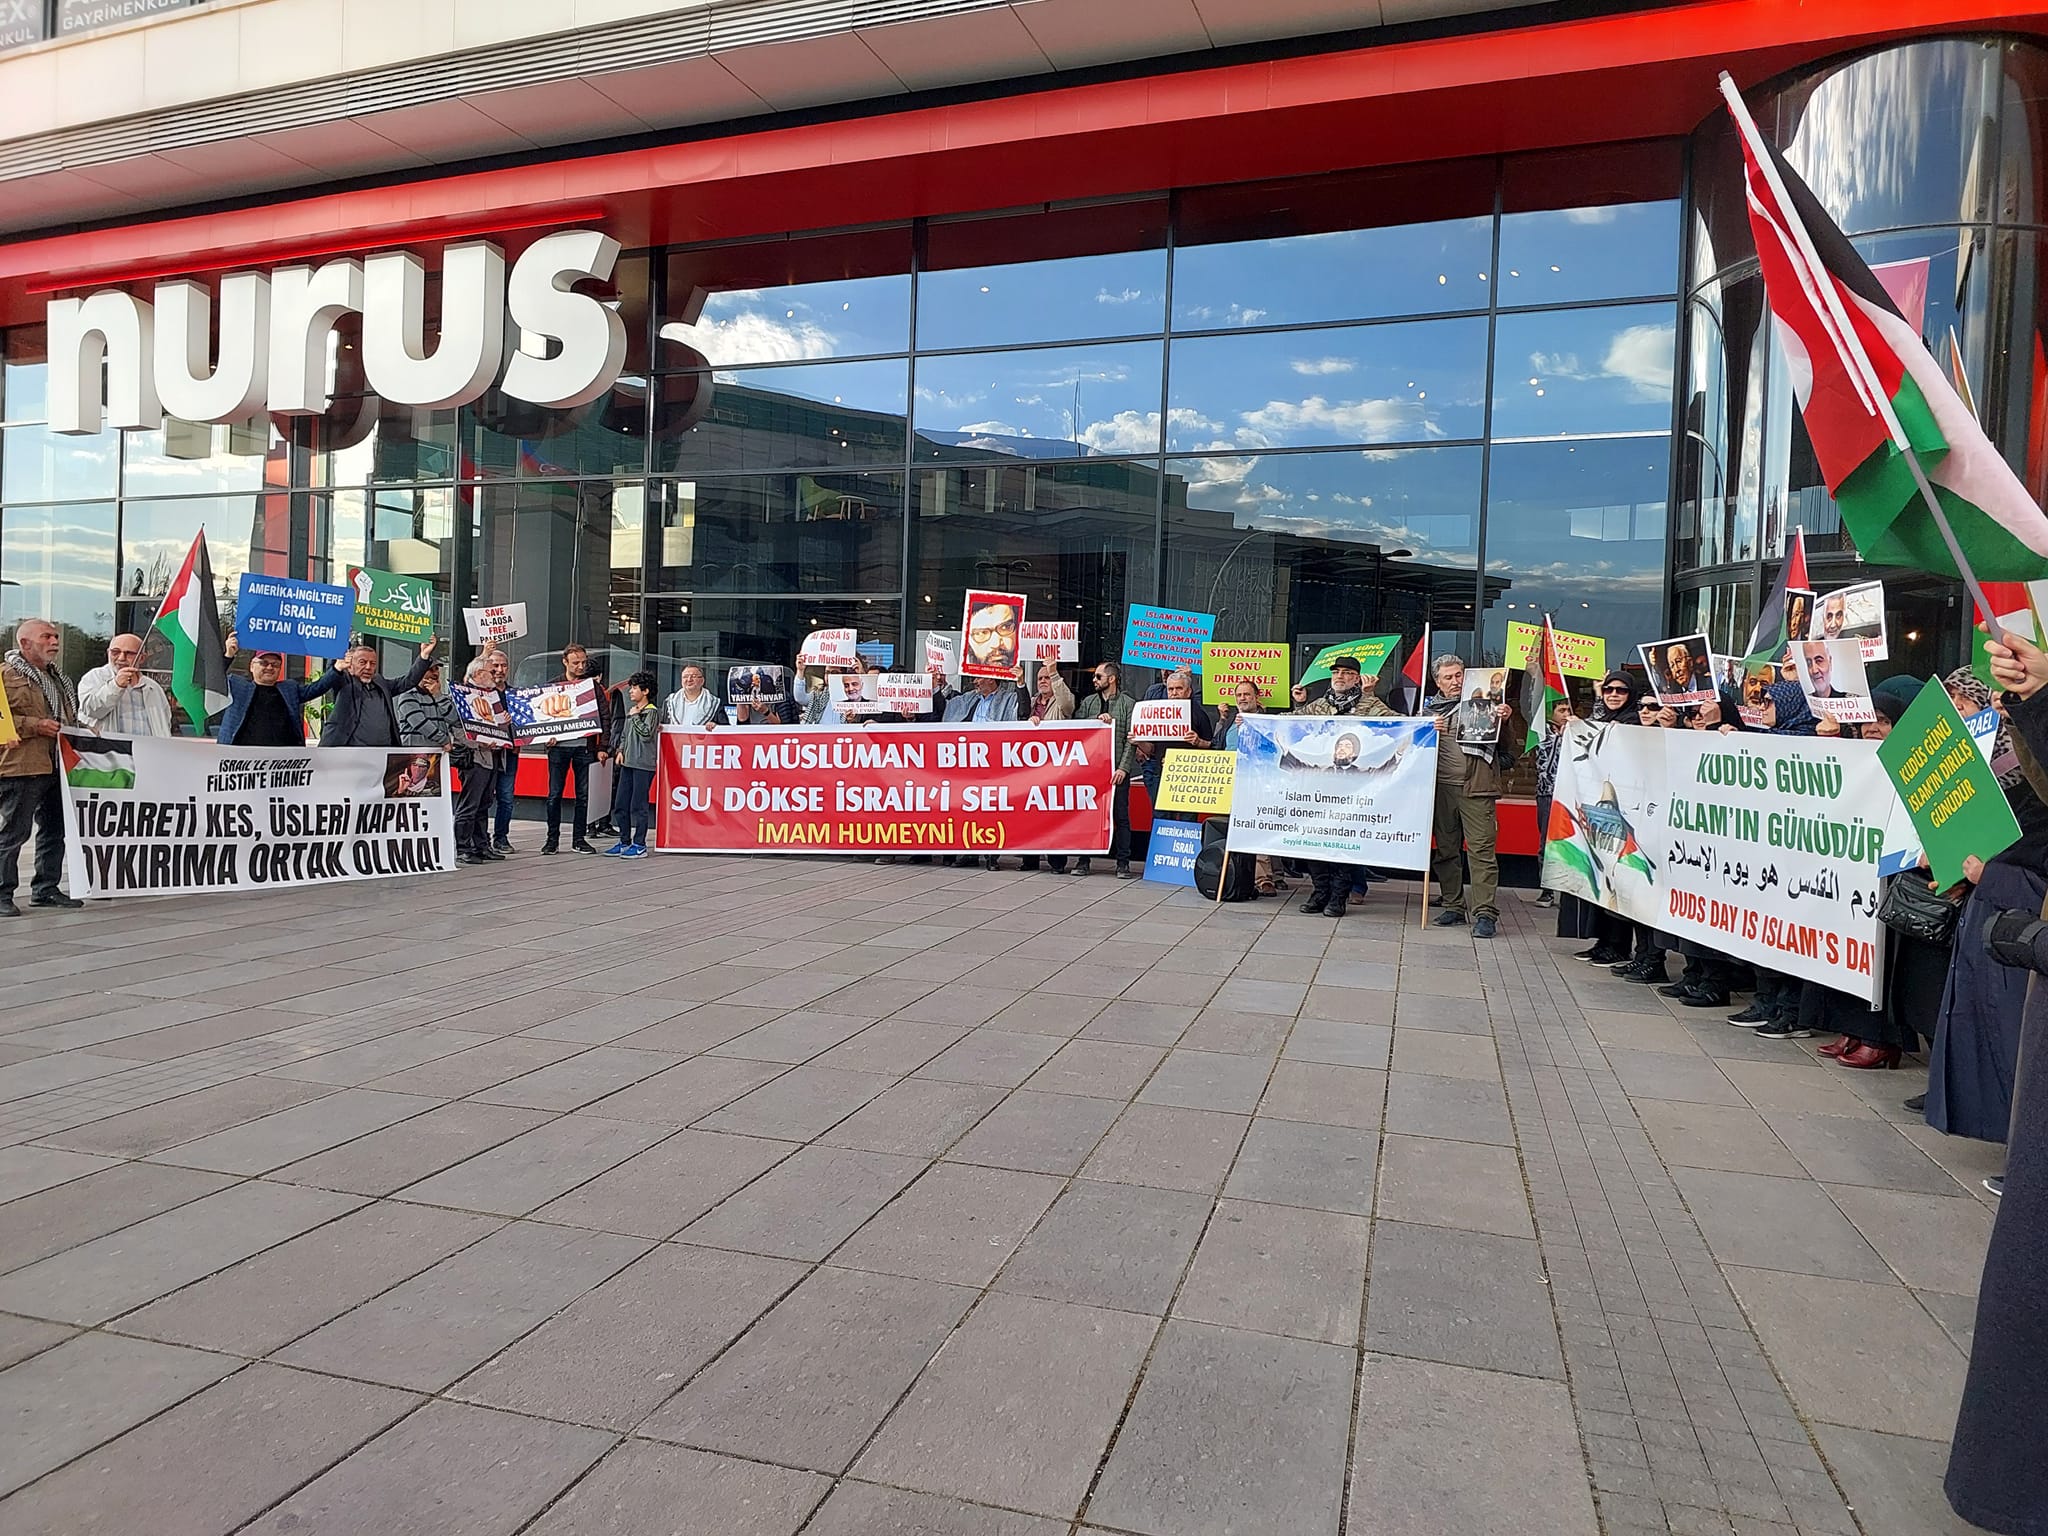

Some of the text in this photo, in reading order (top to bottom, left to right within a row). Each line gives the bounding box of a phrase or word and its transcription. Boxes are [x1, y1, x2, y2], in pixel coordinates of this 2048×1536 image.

[47, 230, 626, 435] nurus
[249, 582, 344, 605] AMERİKA-İNGİLTERE
[280, 600, 316, 620] İSRAİL
[356, 605, 430, 626] MÜSLÜMANLAR
[485, 608, 504, 617] SAVE
[249, 616, 337, 639] ŞEYTAN ÜÇGENİ
[365, 616, 421, 634] KARDEŞTİR
[1132, 619, 1208, 636] MÜSLÜMANLARIN
[1187, 616, 1198, 624] VE
[489, 625, 507, 635] FREE
[820, 631, 841, 640] AQSA
[1021, 624, 1048, 640] HAMAS
[1061, 624, 1076, 640] NOT
[1138, 631, 1155, 639] ASIL
[820, 642, 837, 653] Only
[1036, 644, 1061, 660] ALONE
[1210, 647, 1282, 658] SİYONİZMİN
[803, 654, 853, 665] For Muslims
[1229, 662, 1261, 671] SONU
[878, 685, 896, 697] ÖZGÜR
[1219, 687, 1272, 697] GEEK
[1140, 704, 1182, 719] KÜRECİK
[516, 720, 597, 736] KAHROLSUN AMERİKA
[1133, 724, 1189, 736] KAPATILSIN
[681, 736, 1089, 770] HER MÜSLÜMAN BİR KOVA
[1898, 714, 1953, 785] KUDÜS GÜNÜ
[1175, 754, 1231, 764] KUDÜS'ÜN
[1941, 738, 1976, 782] DİRİLİŞ
[1168, 762, 1234, 775] ÖZGÜRLÜĞÜ
[1696, 749, 1843, 800] KUDÜS GÜNÜ
[207, 769, 314, 792] FİLİSTİN'E İHANET
[1165, 773, 1232, 785] SİYONİZİMLE
[671, 785, 711, 812] SU
[723, 781, 825, 812] DÖKSE
[961, 785, 1014, 812] SEL
[1024, 785, 1098, 811] ALIR
[1169, 783, 1224, 795] MÜCADELE
[1171, 793, 1217, 805] İLE OLUR
[1285, 788, 1311, 802] İslam
[1314, 790, 1353, 805] Ümmeti
[1356, 795, 1374, 808] için
[1929, 778, 1976, 828] GÜNÜDÜR
[76, 793, 430, 842] TİCARETİ KES, ÜSLERİ KAPAT;
[1256, 805, 1392, 826] yenilgi dönemi kapanmıştır!
[757, 818, 1005, 849] İMAM HUMEYNİ (ks)
[1233, 814, 1256, 829] İsrail
[1258, 818, 1300, 833] örümcek
[1301, 825, 1356, 838] yuvasından
[1360, 828, 1373, 839] da
[1283, 837, 1301, 846] Seyyid
[1323, 841, 1361, 851] NASRALLAH
[1768, 808, 1885, 865] GÜNÜDÜR
[1172, 840, 1195, 855] İSRAİL
[250, 841, 349, 882] ORTAK
[353, 837, 444, 877] OLMA!
[1153, 854, 1179, 868] ŞEYTAN
[1722, 861, 1749, 888] يوم
[1755, 863, 1779, 891] هو
[1787, 868, 1840, 902] القدس
[1669, 888, 1706, 924] QUDS
[1710, 899, 1738, 933] DAY
[1742, 909, 1758, 940] IS
